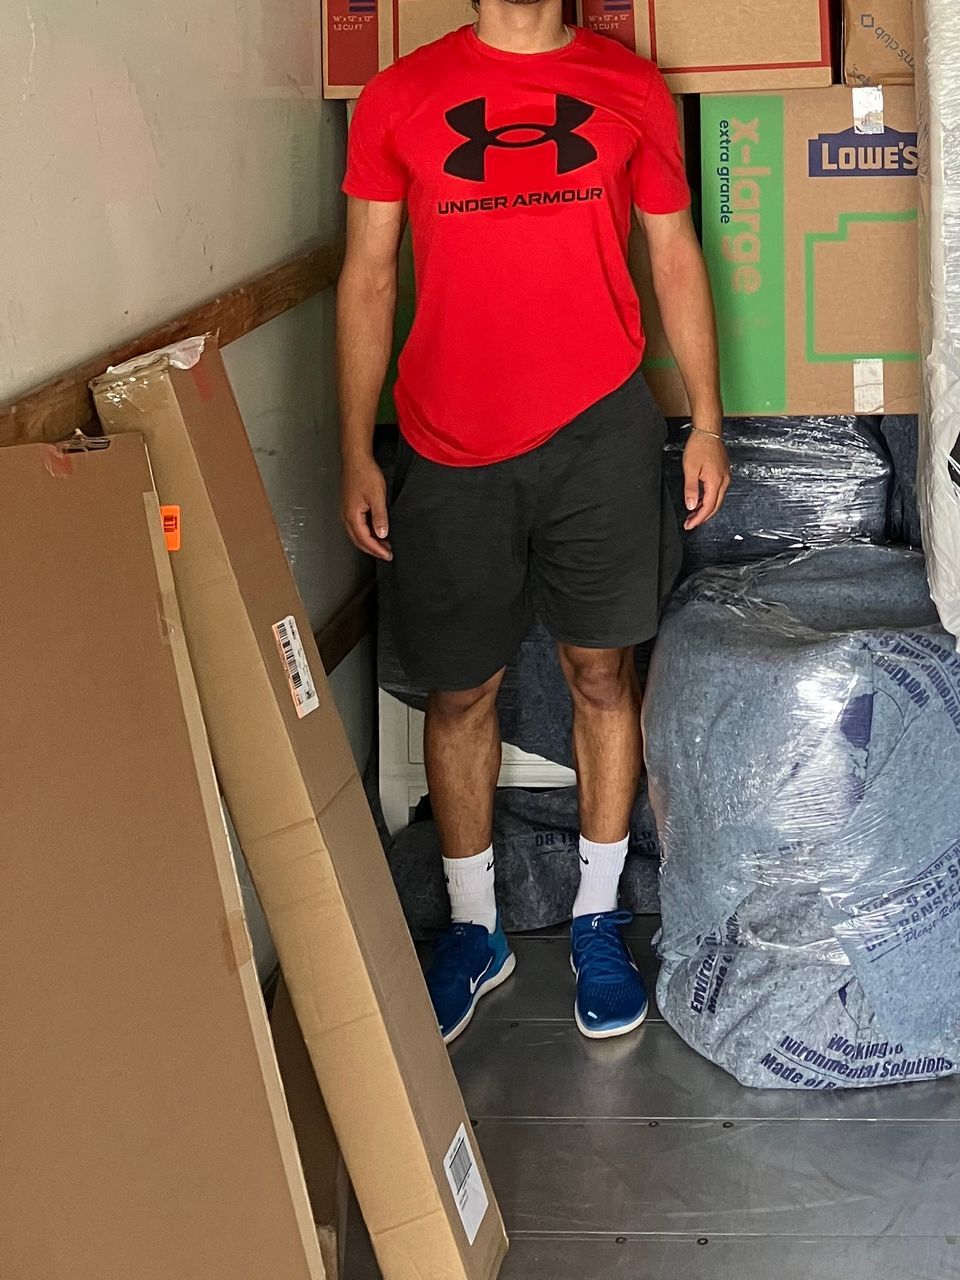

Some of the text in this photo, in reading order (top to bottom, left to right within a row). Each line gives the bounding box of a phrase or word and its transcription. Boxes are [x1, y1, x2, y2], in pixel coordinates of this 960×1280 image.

[875, 27, 899, 51] club
[822, 142, 919, 170] LOWE'S
[717, 120, 733, 224] extra grande
[438, 187, 603, 215] UNDER ARMOUR
[721, 117, 771, 294] x-large
[707, 965, 728, 1015] Made
[760, 1053, 803, 1084] Made
[880, 1056, 953, 1079] Solutions
